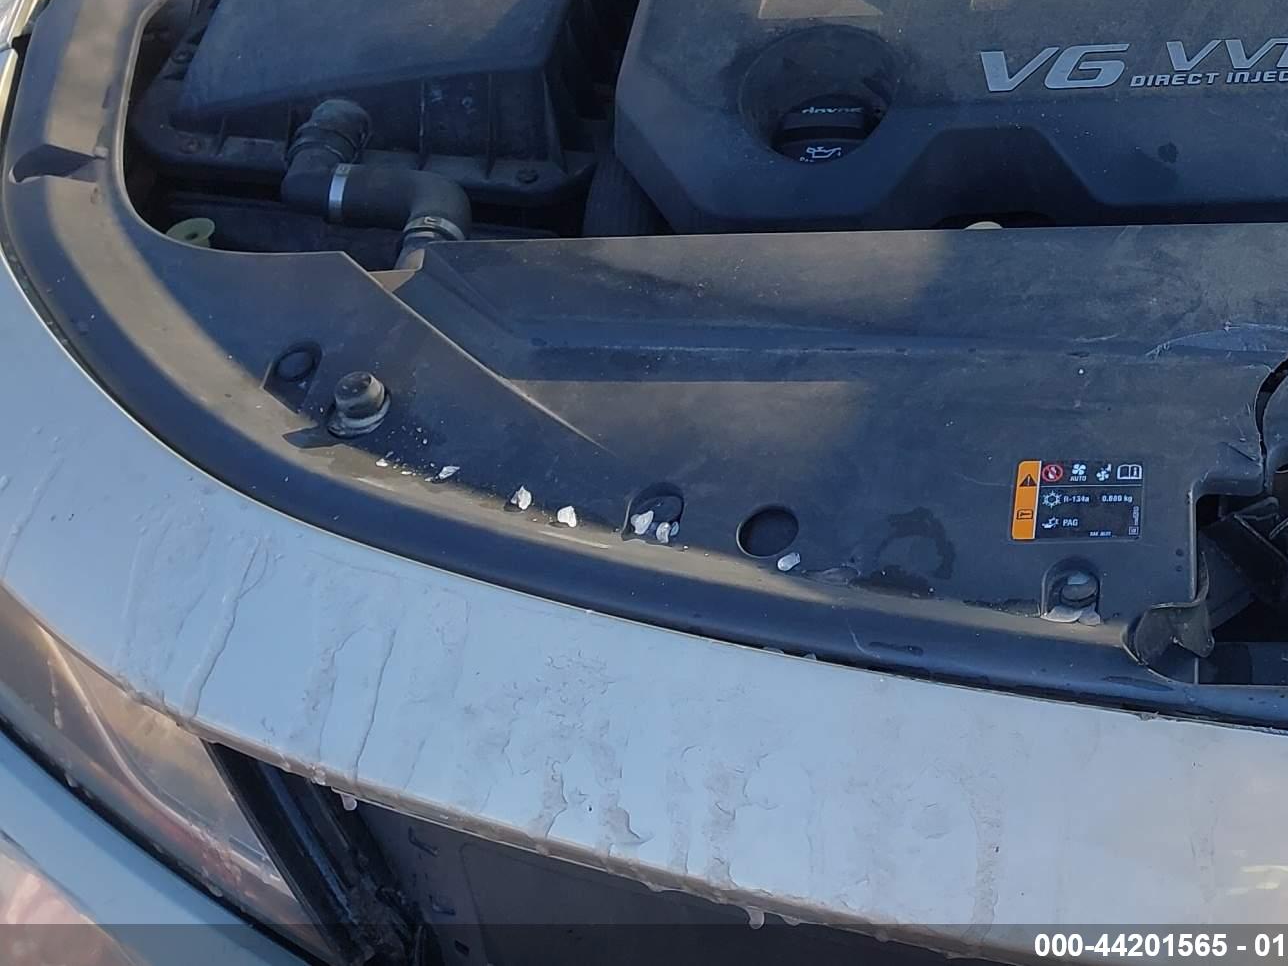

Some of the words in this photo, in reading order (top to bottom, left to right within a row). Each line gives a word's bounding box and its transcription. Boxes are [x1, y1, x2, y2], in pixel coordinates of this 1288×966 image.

[980, 43, 1130, 92] V6
[1130, 72, 1220, 87] DIRECT
[1062, 517, 1079, 527] PAG
